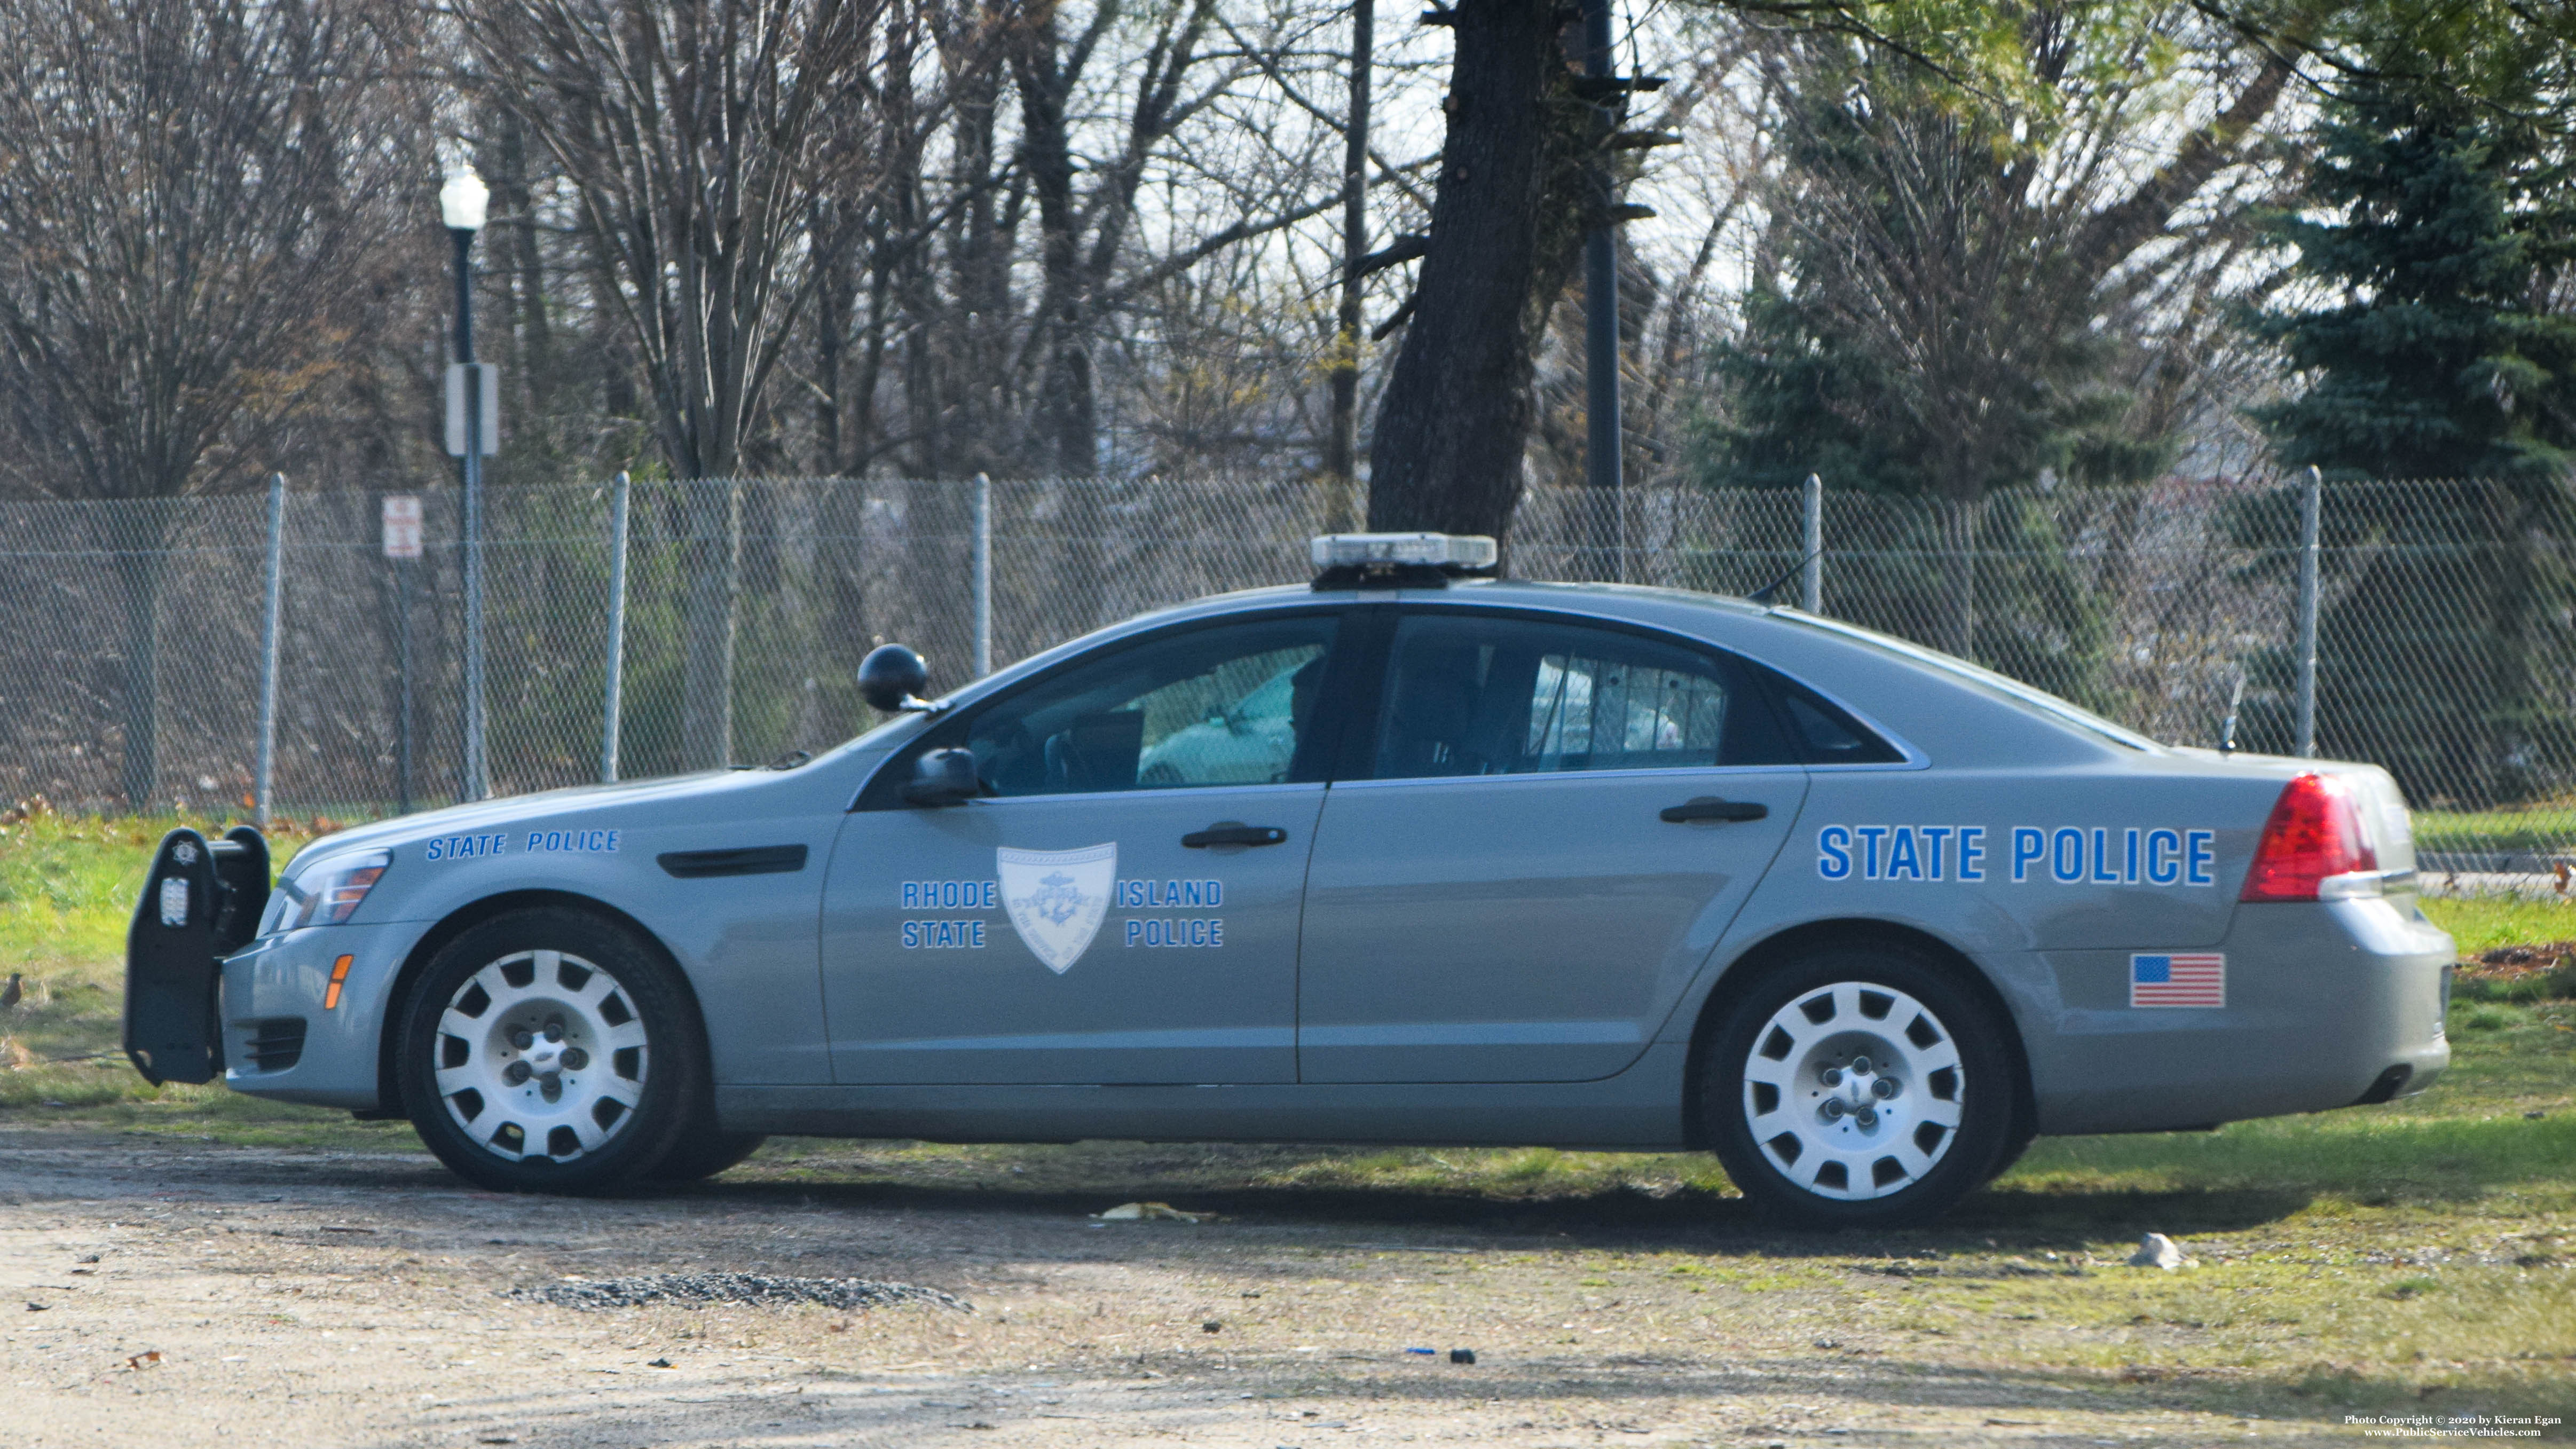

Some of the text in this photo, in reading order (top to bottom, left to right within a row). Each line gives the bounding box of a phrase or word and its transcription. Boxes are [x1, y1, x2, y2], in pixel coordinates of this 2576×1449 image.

[428, 830, 620, 860] STATE POLICE
[1817, 825, 2215, 887] STATE POLICE
[901, 879, 1223, 909] RHODE ISLAND
[901, 920, 986, 948] STATE
[1125, 919, 1223, 947] POLICE
